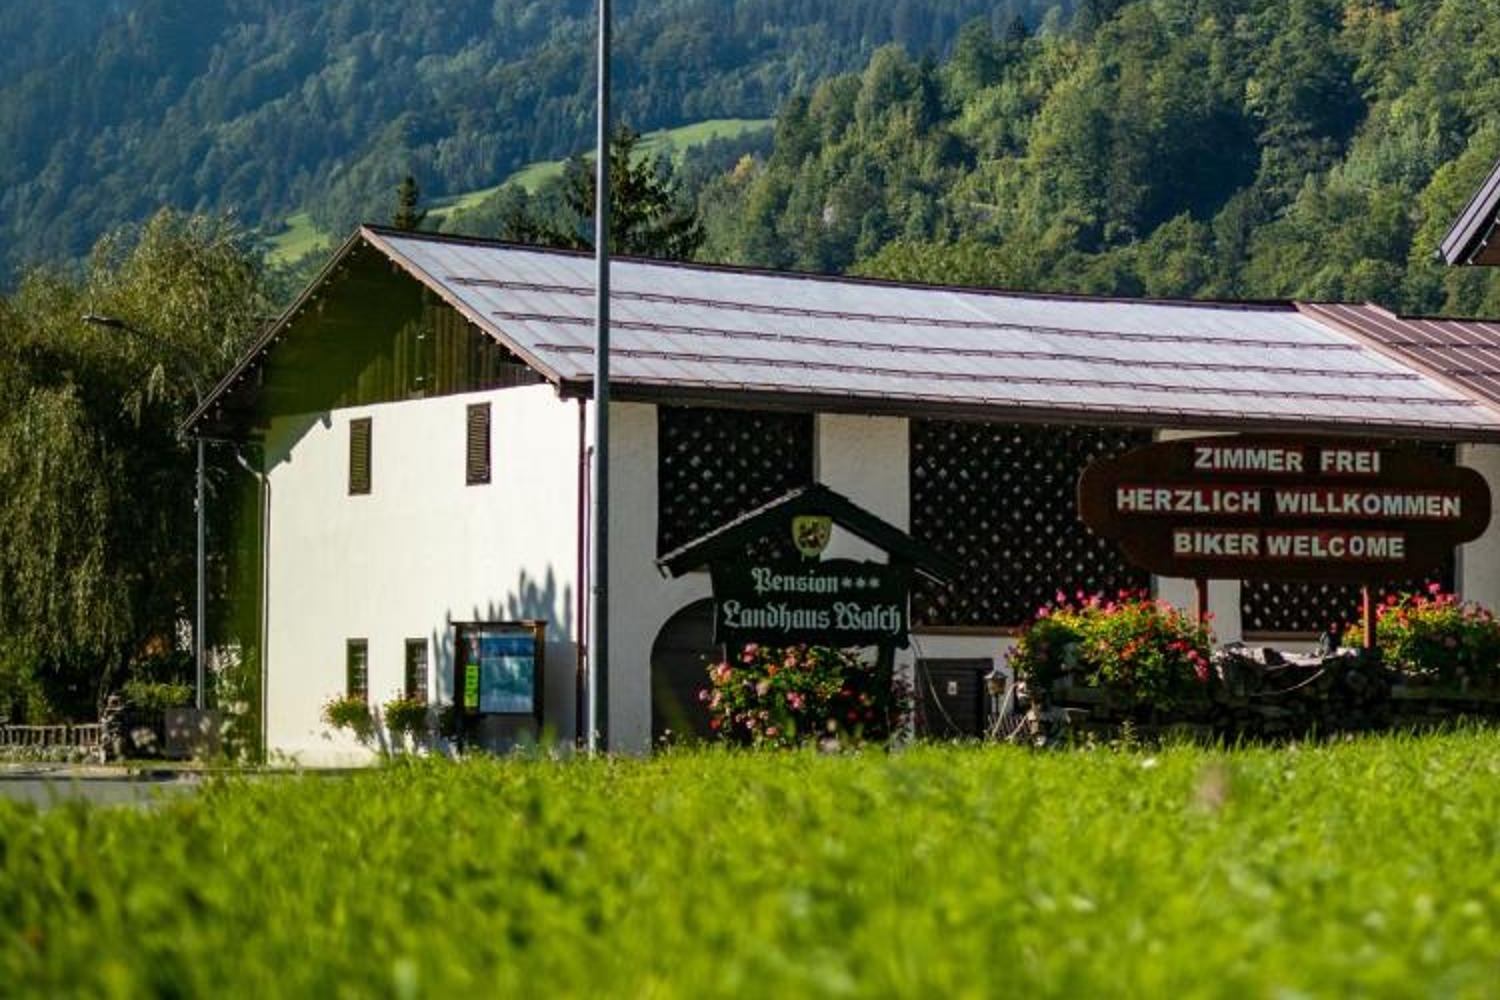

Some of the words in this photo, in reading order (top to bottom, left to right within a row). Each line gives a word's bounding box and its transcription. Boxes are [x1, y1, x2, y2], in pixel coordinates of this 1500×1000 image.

[1194, 447, 1303, 472] ZIMMER
[1320, 450, 1380, 473] FREI
[1116, 488, 1261, 513] HERZLICH
[1275, 491, 1461, 517] WILLKOMMEN
[1173, 532, 1260, 556] BIKER
[1267, 534, 1406, 559] WELCOME
[751, 566, 839, 596] Pension
[722, 600, 831, 633] Landhaus
